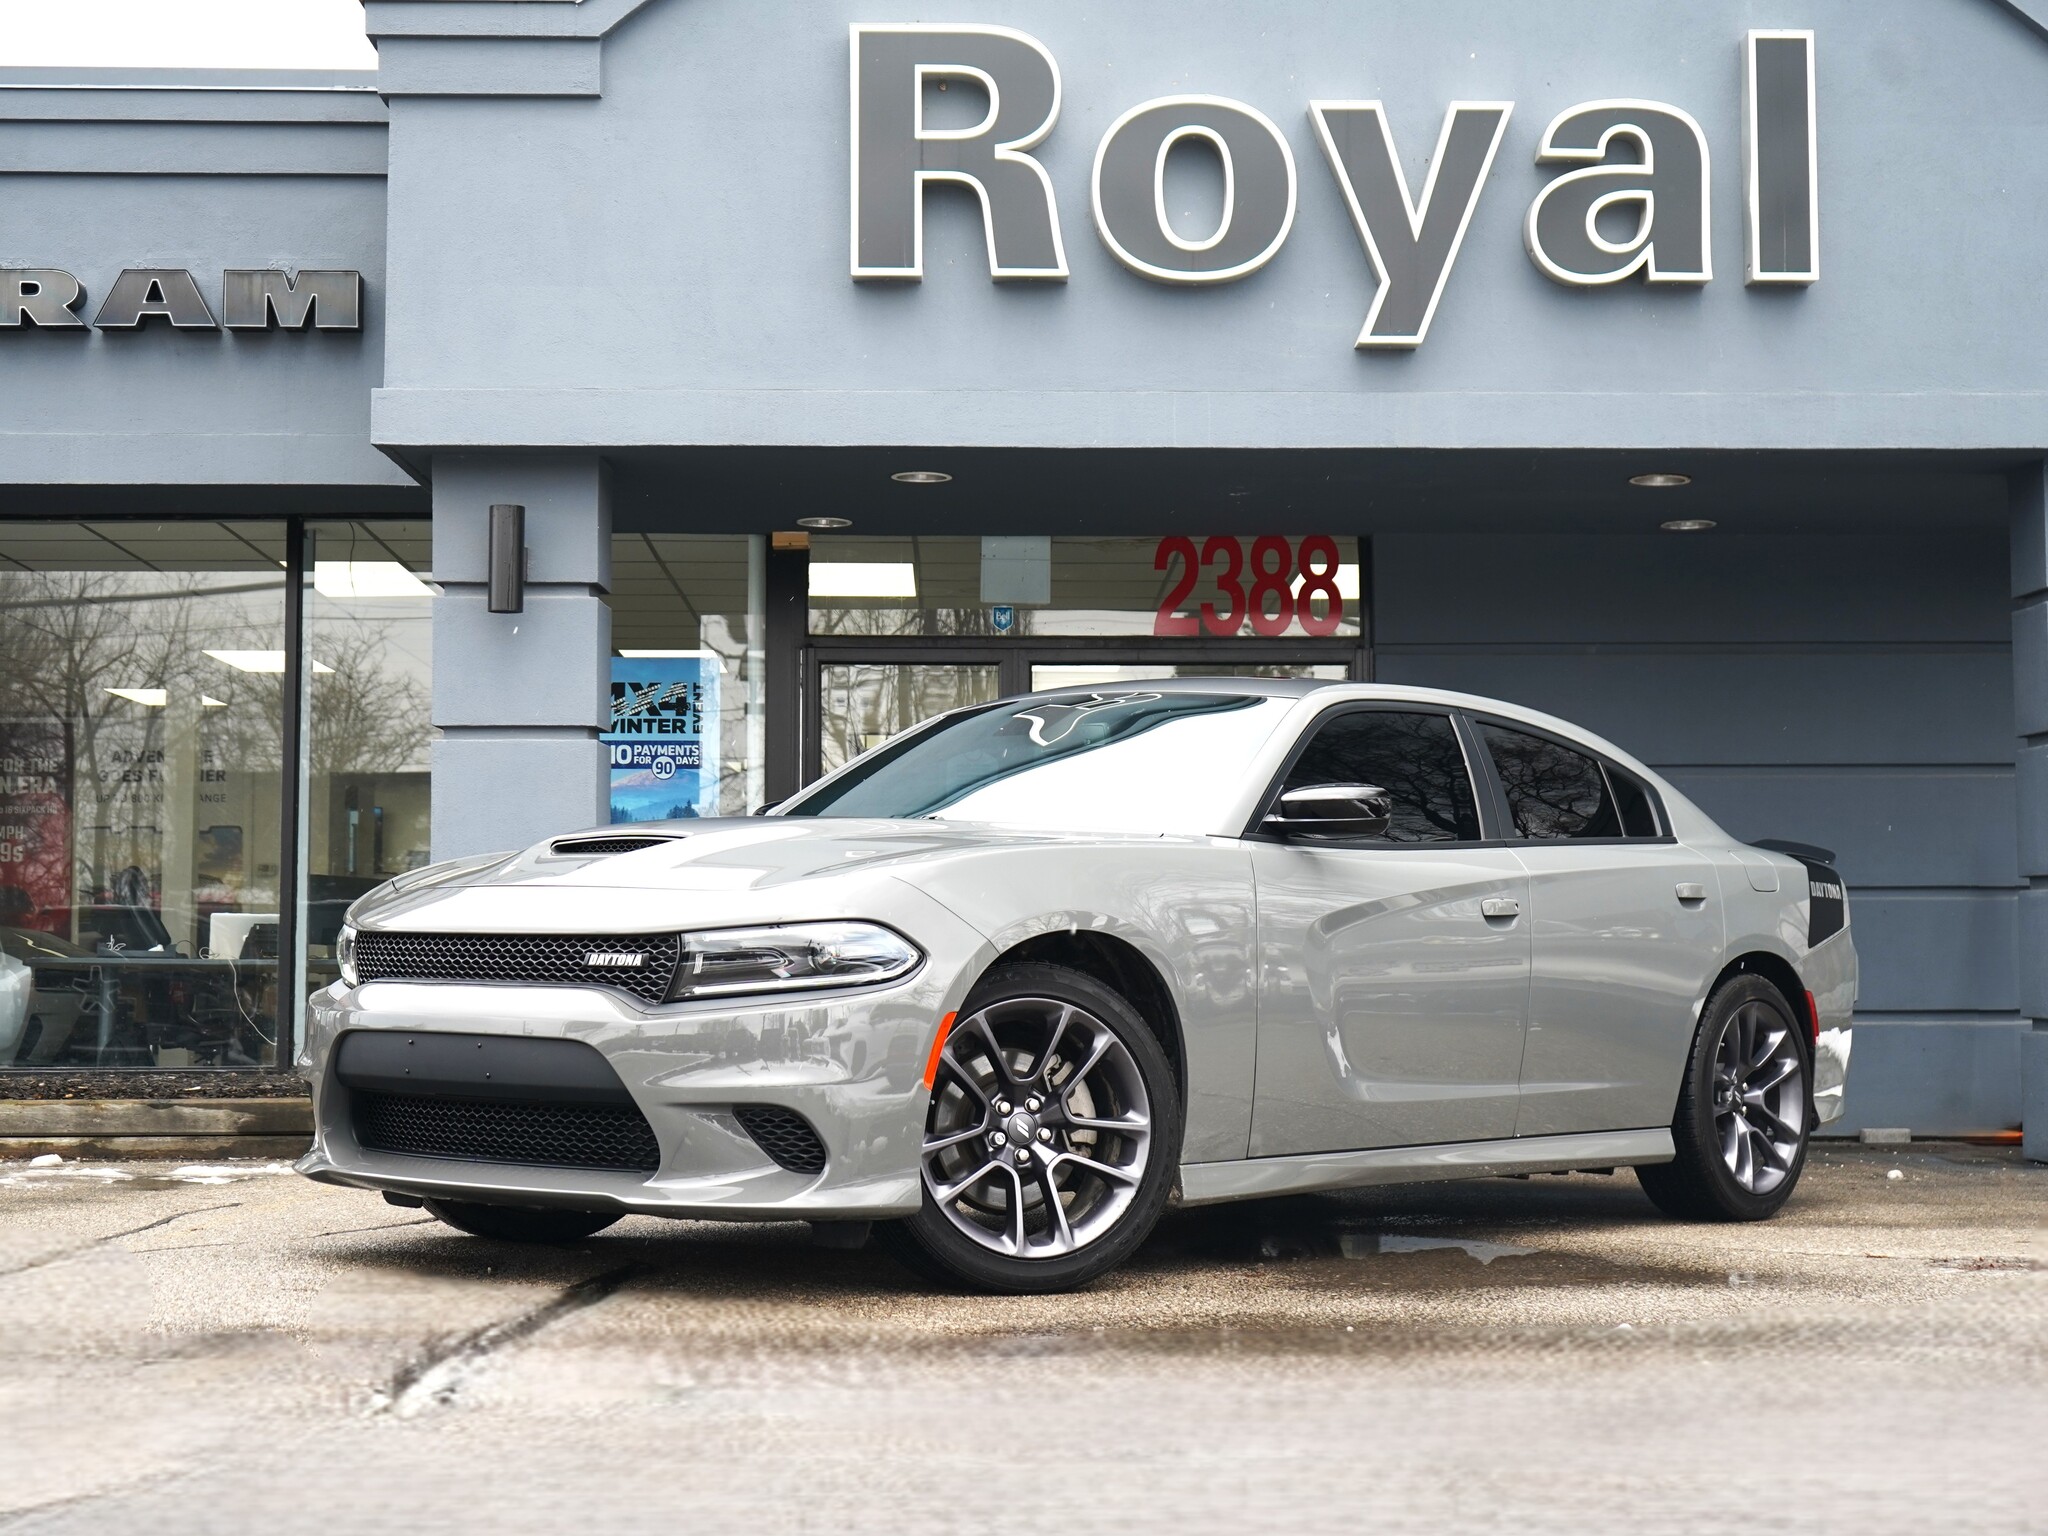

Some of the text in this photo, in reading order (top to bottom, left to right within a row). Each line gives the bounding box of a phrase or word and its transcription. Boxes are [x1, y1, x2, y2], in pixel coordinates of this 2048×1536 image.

[849, 22, 1820, 349] Royal
[0, 269, 364, 332] RAM
[1153, 535, 1343, 637] 2388
[692, 682, 704, 734] EVENT
[634, 744, 700, 756] PAYMENTS
[634, 756, 700, 775] FOR 90 DAYS
[1810, 881, 1842, 899] DAYTONA
[587, 953, 643, 966] DAYTONA
